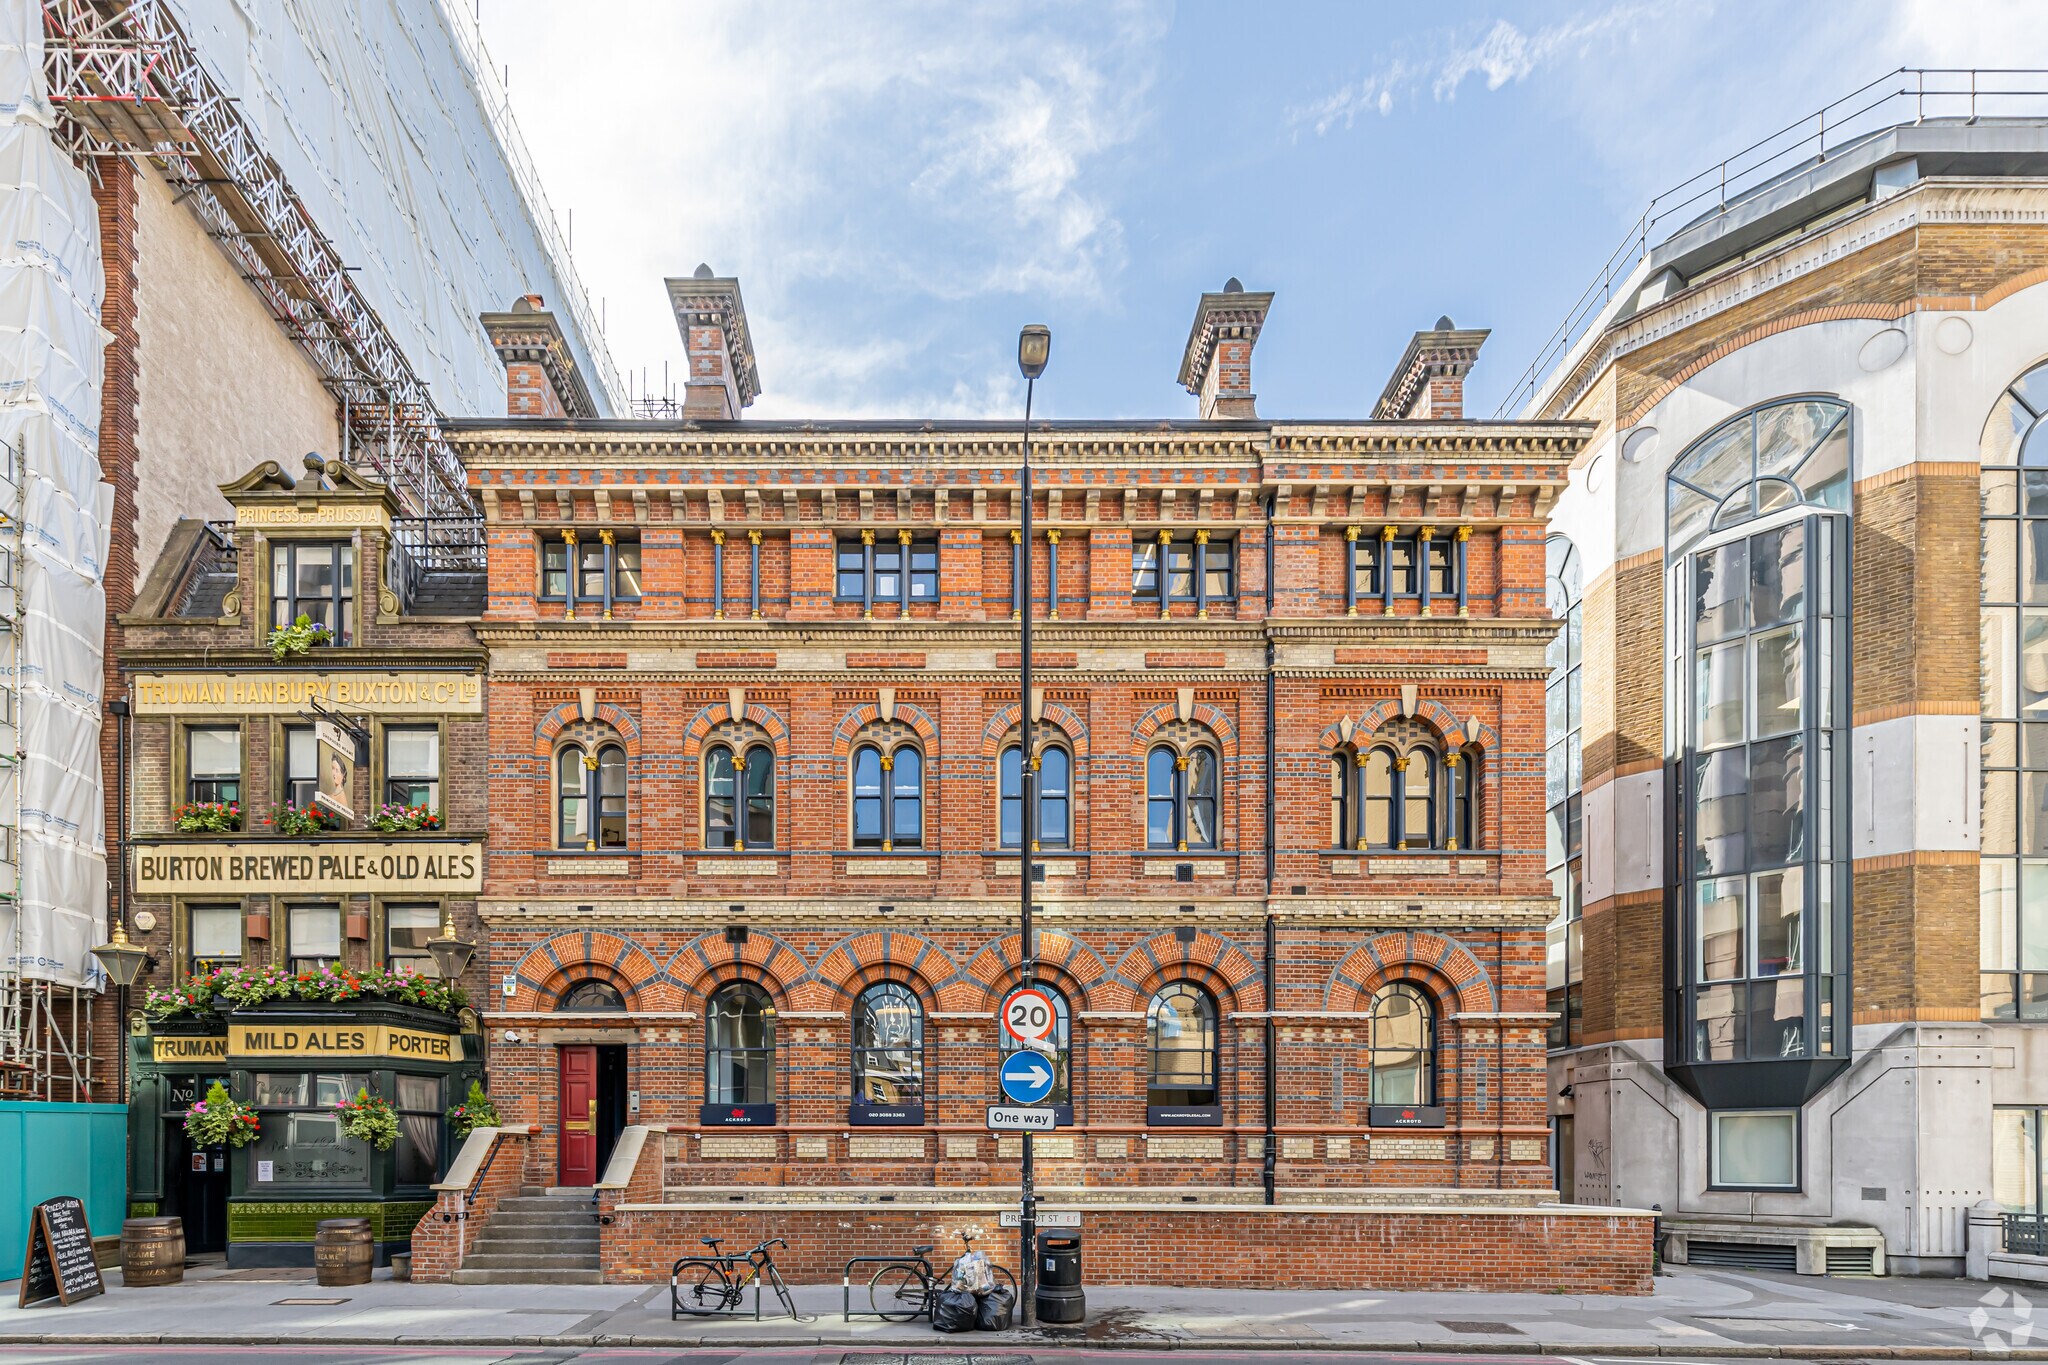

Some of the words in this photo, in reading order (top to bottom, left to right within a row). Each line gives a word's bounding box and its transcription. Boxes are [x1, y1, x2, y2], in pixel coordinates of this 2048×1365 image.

[237, 508, 300, 523] PRINCESS
[301, 513, 315, 523] OF
[318, 507, 378, 522] PRUSSIA
[139, 682, 226, 704] TRUMAN
[232, 682, 331, 704] HANBURY
[337, 682, 417, 703] BUXTON
[420, 684, 432, 701] &
[141, 856, 223, 881] BURTON
[230, 856, 313, 880] BREWED
[319, 855, 366, 880] PALE
[367, 860, 378, 876] &
[381, 855, 419, 880] OLD
[424, 855, 475, 880] ALES
[1011, 1005, 1047, 1027] 20
[245, 1032, 298, 1050] MILD
[305, 1032, 365, 1050] ALES
[389, 1033, 450, 1056] PORTER
[993, 1111, 1019, 1123] One
[1023, 1114, 1049, 1126] way
[1005, 1214, 1045, 1223] PREOT
[1048, 1214, 1059, 1222] ST
